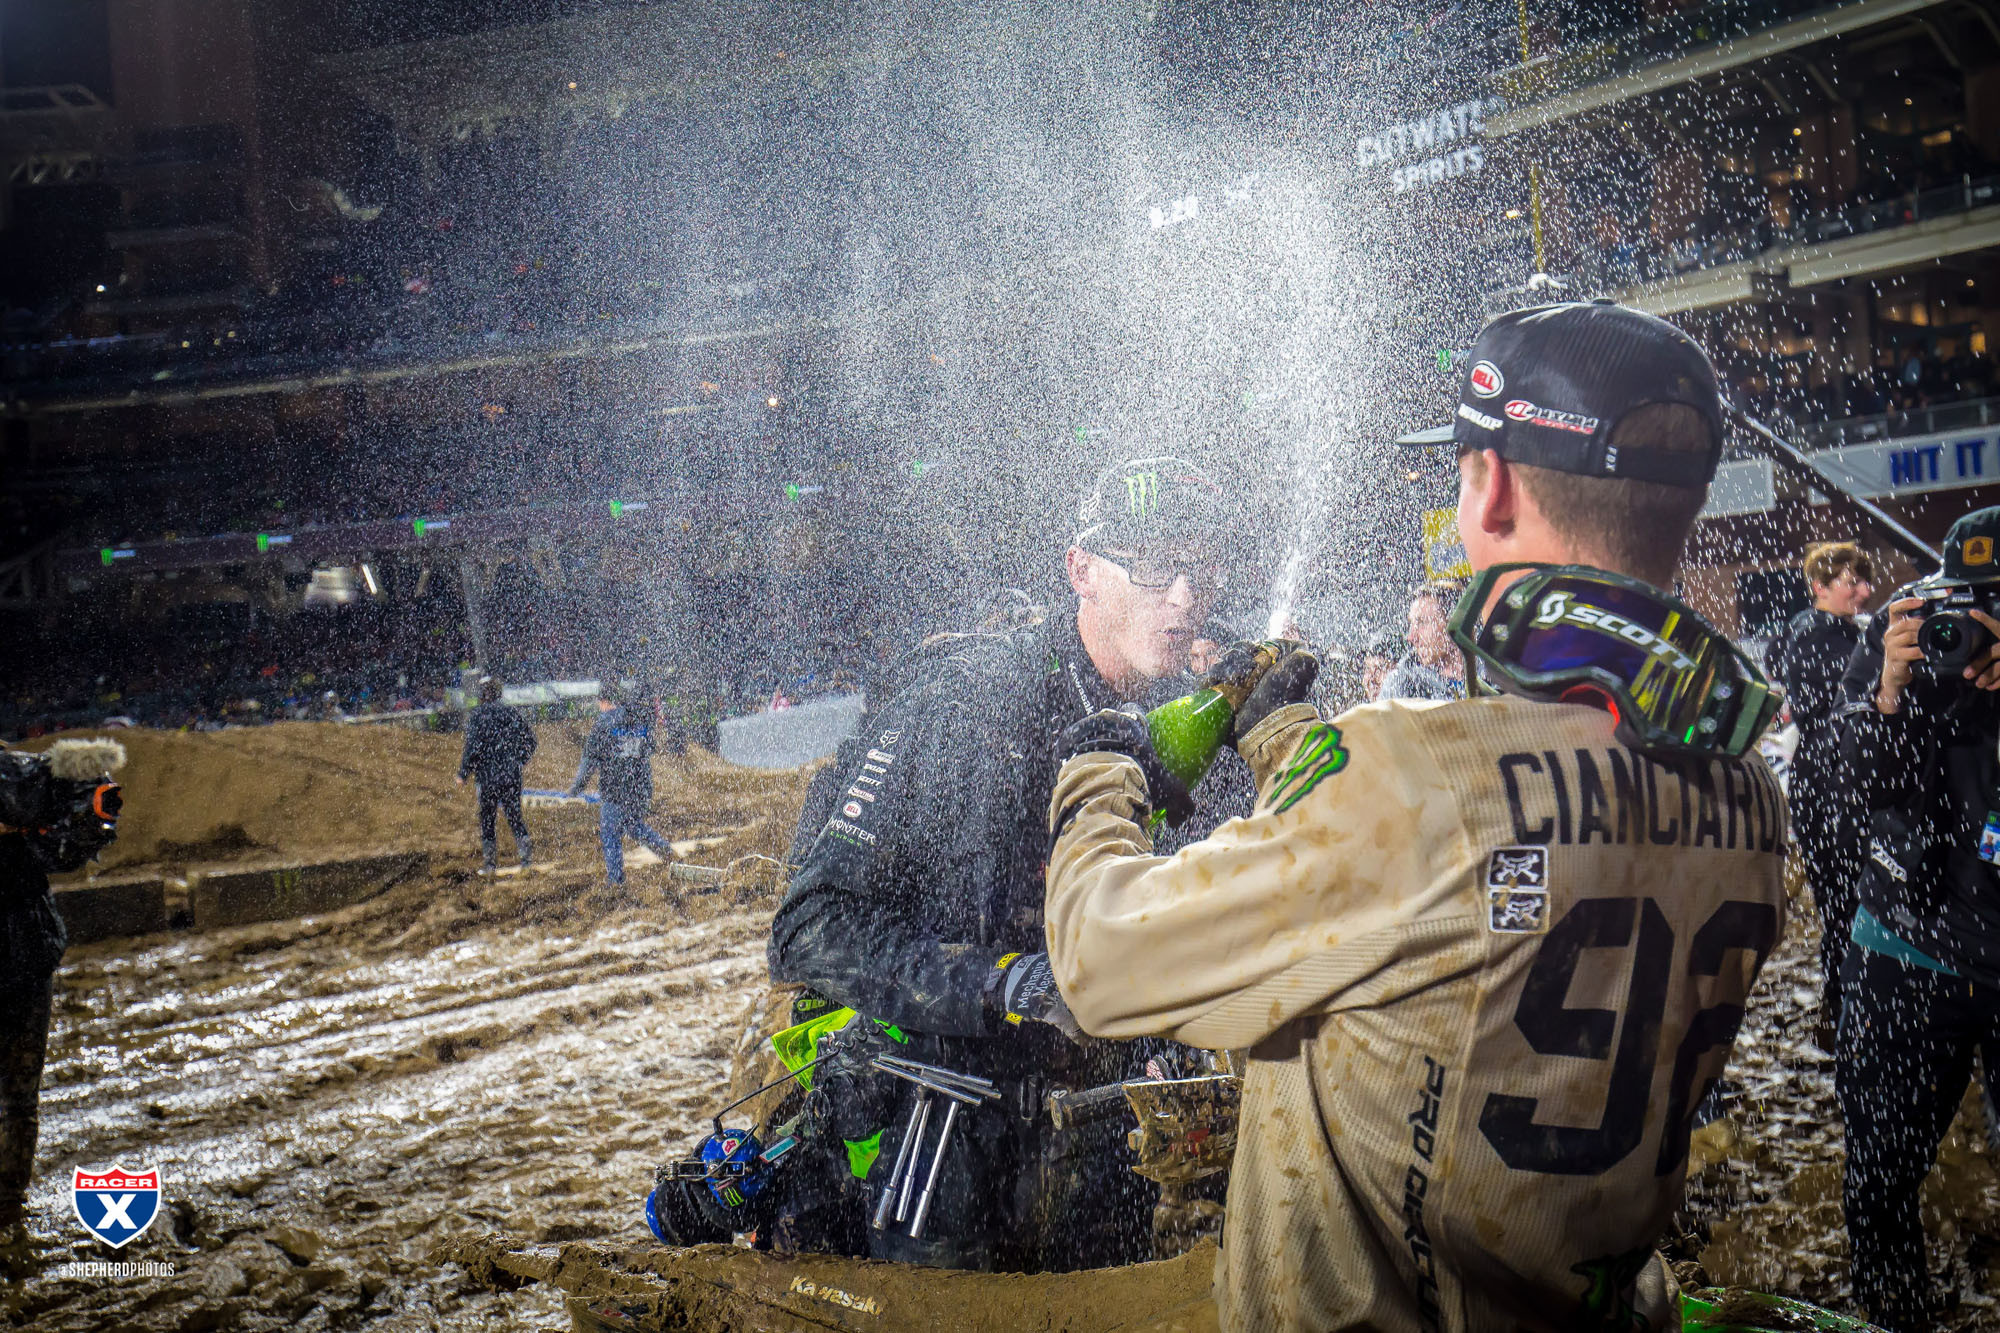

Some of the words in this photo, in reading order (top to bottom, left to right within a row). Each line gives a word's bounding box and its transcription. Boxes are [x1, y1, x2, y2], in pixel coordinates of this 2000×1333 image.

[1392, 145, 1484, 195] SPIRITS
[1472, 369, 1494, 391] BELL
[1605, 444, 1618, 472] FOX
[1889, 444, 1941, 486] HIT
[1955, 438, 1986, 477] IT
[1564, 605, 1697, 670] SCOTT
[829, 818, 877, 846] MONSTER
[846, 804, 859, 815] BELL
[1017, 960, 1048, 1009] Mechanix
[1479, 896, 1778, 1178] 92
[1408, 1055, 1446, 1163] PRO
